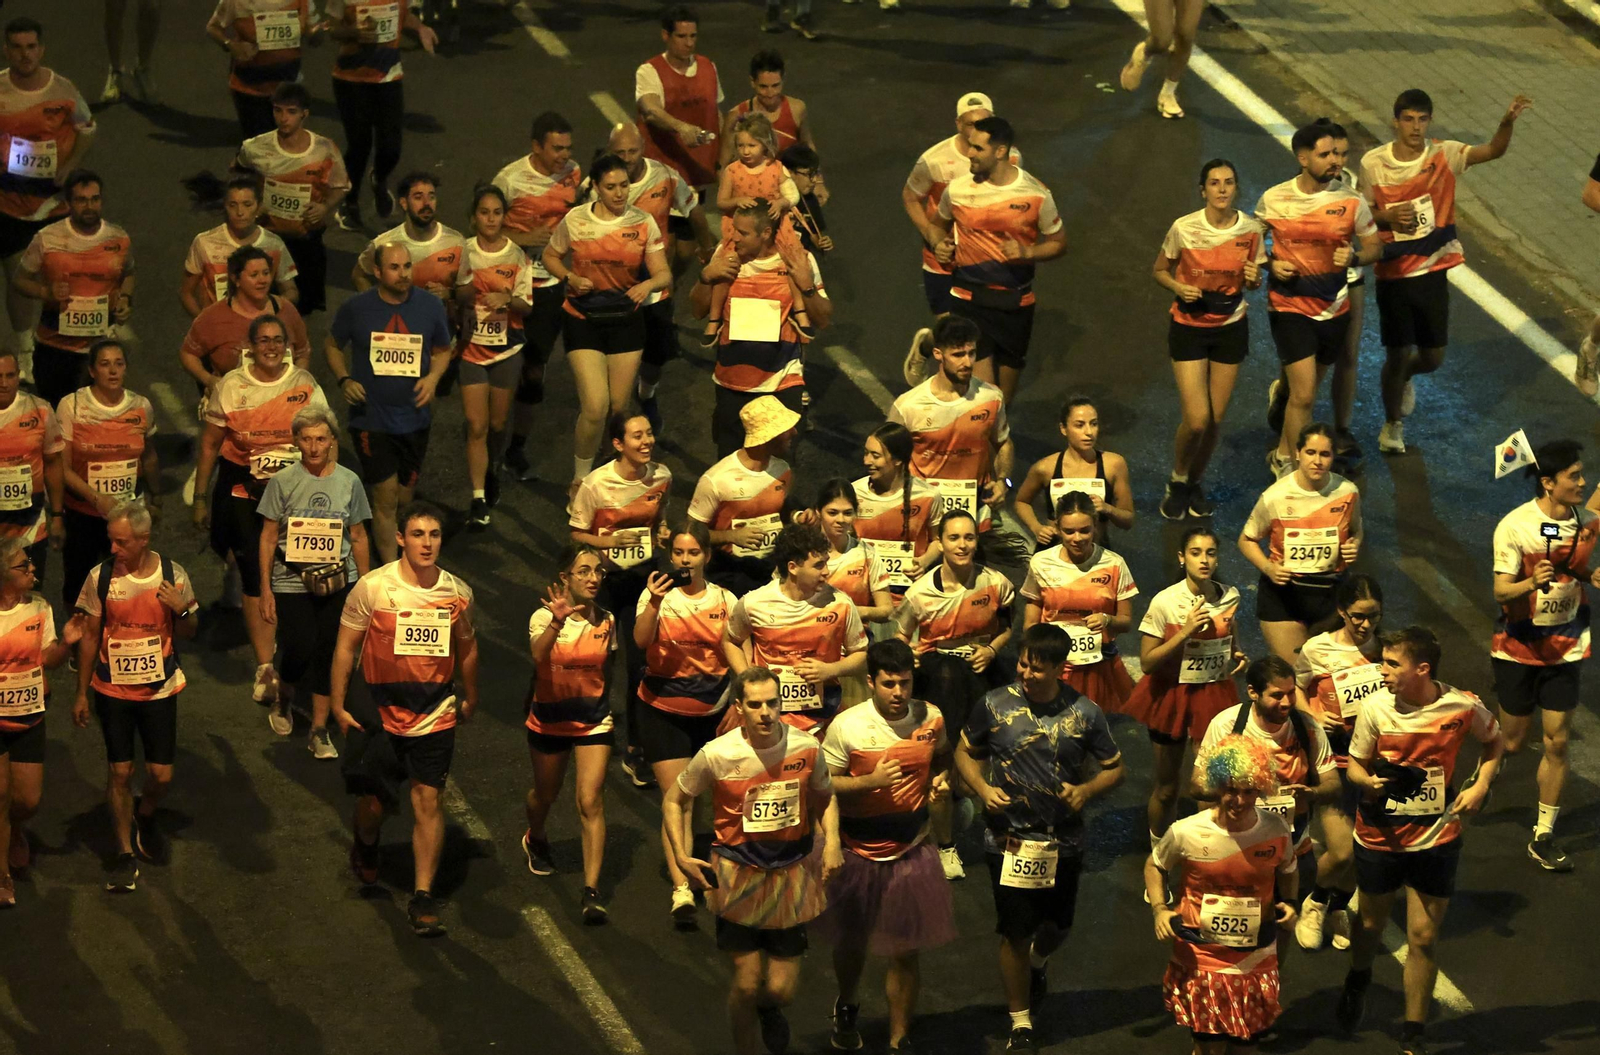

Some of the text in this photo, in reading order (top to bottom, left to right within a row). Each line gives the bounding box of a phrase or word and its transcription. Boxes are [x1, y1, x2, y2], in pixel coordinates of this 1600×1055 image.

[264, 26, 293, 39] 7788
[375, 19, 392, 32] 87
[15, 153, 52, 169] 19729
[271, 195, 300, 211] 9299
[66, 312, 103, 325] 15030
[375, 350, 415, 364] 20005
[0, 484, 28, 499] 894
[95, 477, 132, 493] 11896
[293, 536, 335, 551] 17930
[1290, 546, 1332, 561] 23479
[882, 558, 902, 573] 32
[405, 628, 439, 643] 9390
[115, 655, 157, 672] 12735
[1186, 655, 1225, 671] 22733
[0, 687, 39, 704] 12739
[754, 801, 788, 818] 5734
[1014, 859, 1048, 876] 5526
[1211, 917, 1249, 934] 5525
